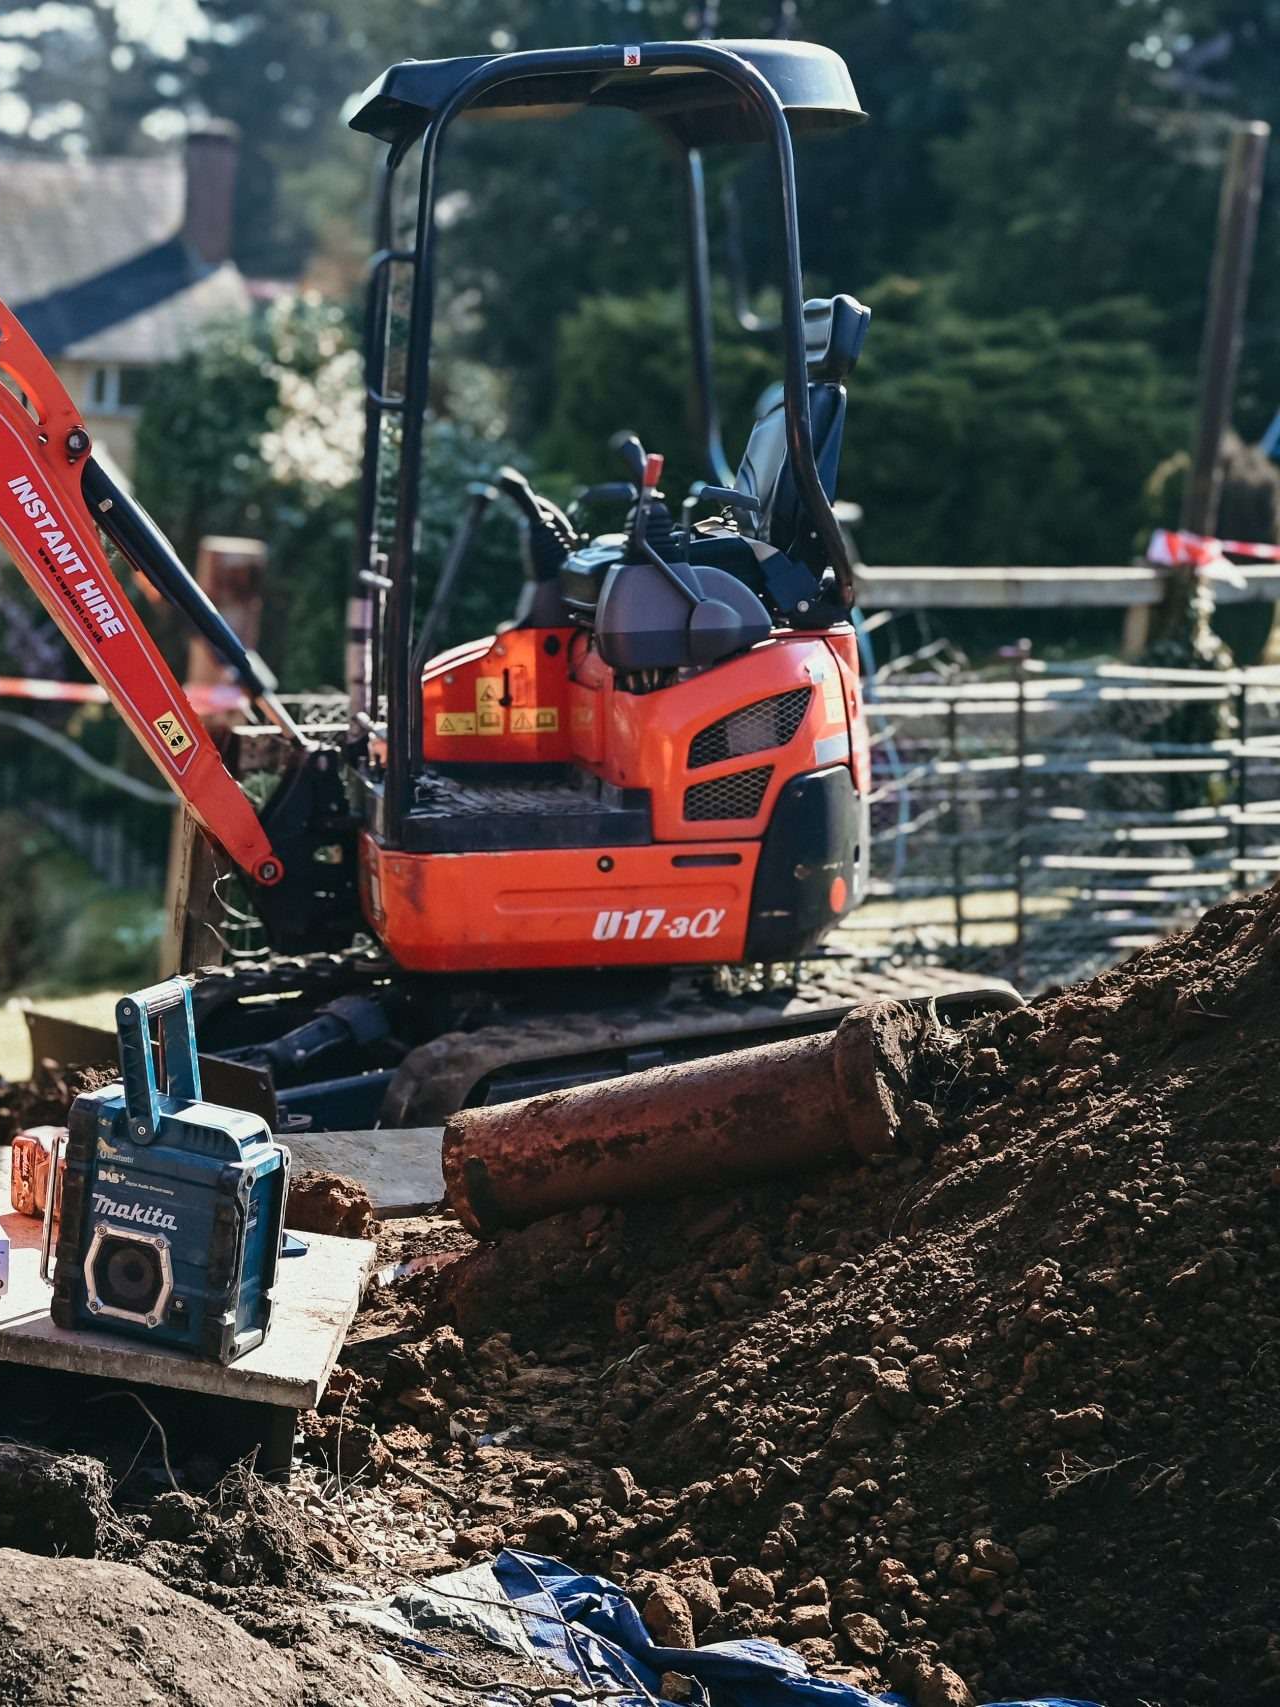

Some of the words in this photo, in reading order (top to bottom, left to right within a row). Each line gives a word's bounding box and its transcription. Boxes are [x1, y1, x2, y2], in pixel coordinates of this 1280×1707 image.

[7, 475, 88, 576] INSTANT
[74, 578, 127, 640] HIRE
[37, 547, 104, 645] www.cwplant.co.uk
[98, 1169, 127, 1184] DAB+
